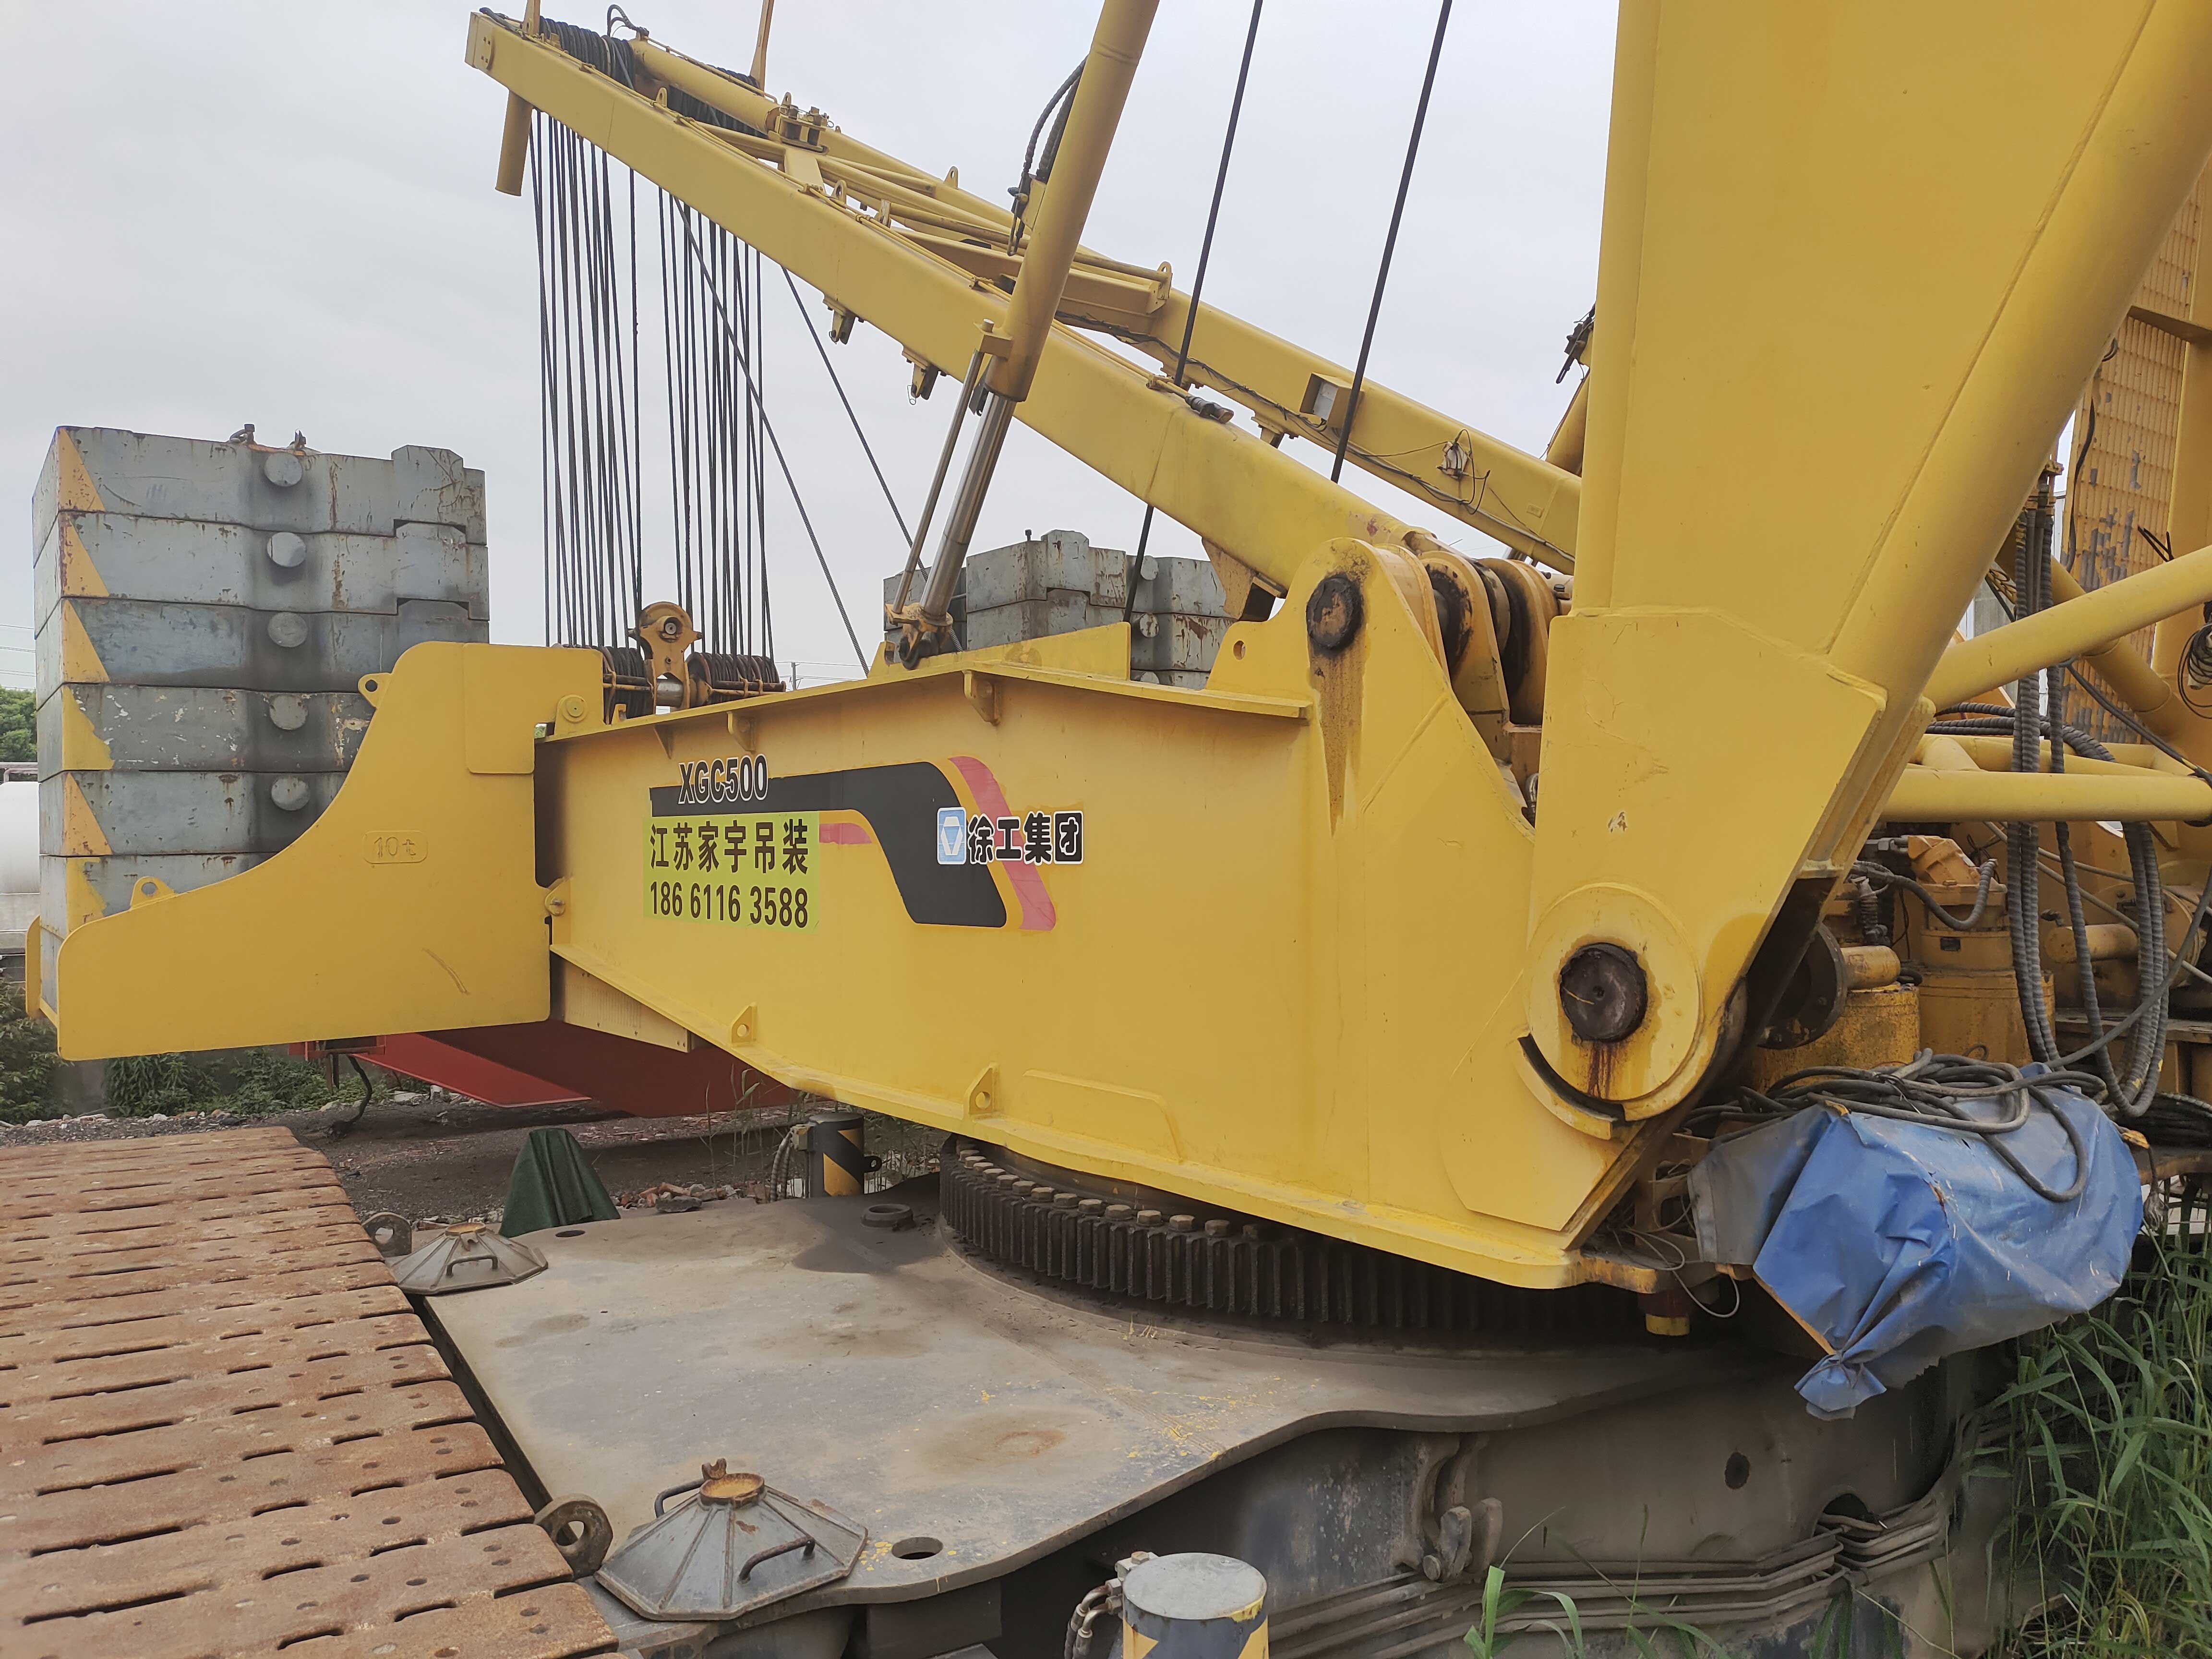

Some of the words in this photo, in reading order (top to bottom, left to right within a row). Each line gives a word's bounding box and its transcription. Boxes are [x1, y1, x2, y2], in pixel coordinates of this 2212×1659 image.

[678, 754, 768, 804] XGC500
[650, 818, 808, 875] 江苏家宇吊装
[968, 811, 1083, 866] 徐工集团
[650, 881, 682, 916] 186
[691, 883, 741, 922] 6116
[750, 886, 808, 928] 3588
